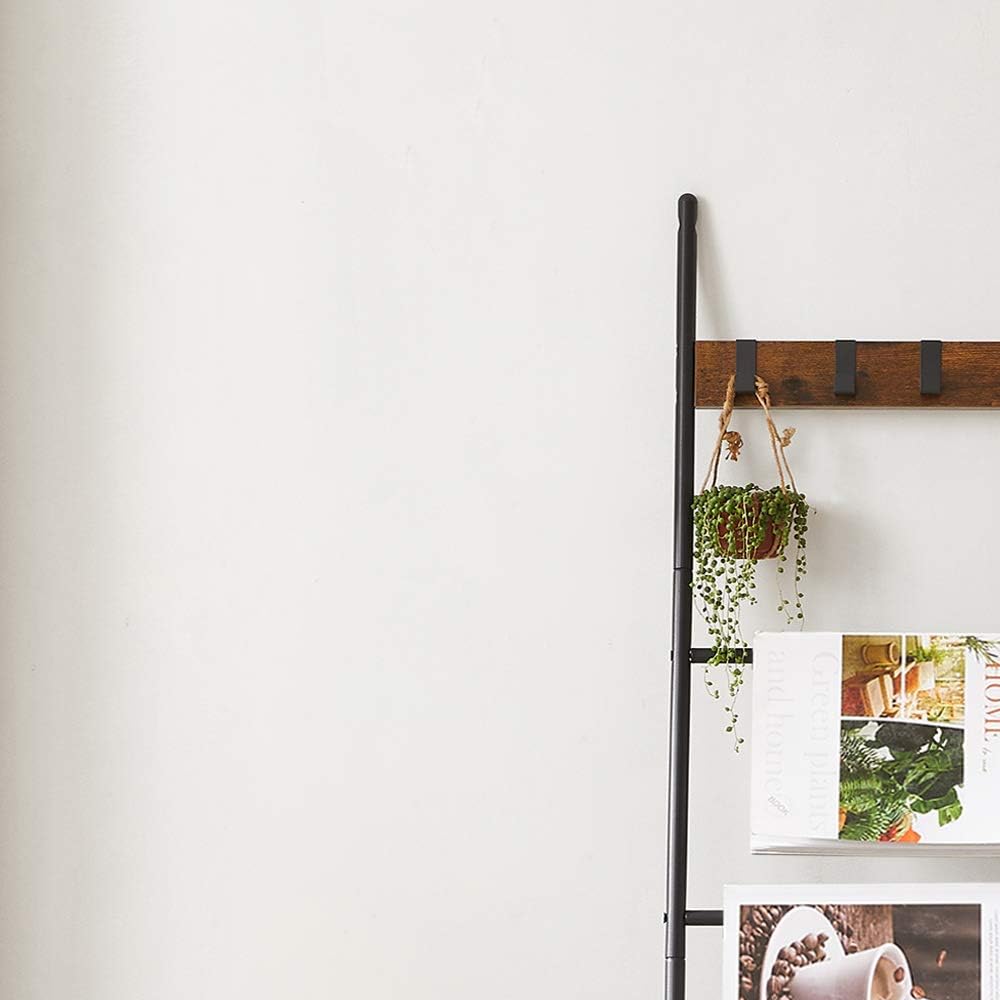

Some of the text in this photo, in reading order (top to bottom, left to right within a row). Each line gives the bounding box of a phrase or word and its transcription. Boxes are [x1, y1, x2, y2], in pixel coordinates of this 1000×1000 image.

[767, 650, 796, 703] and
[803, 651, 839, 832] Green plants
